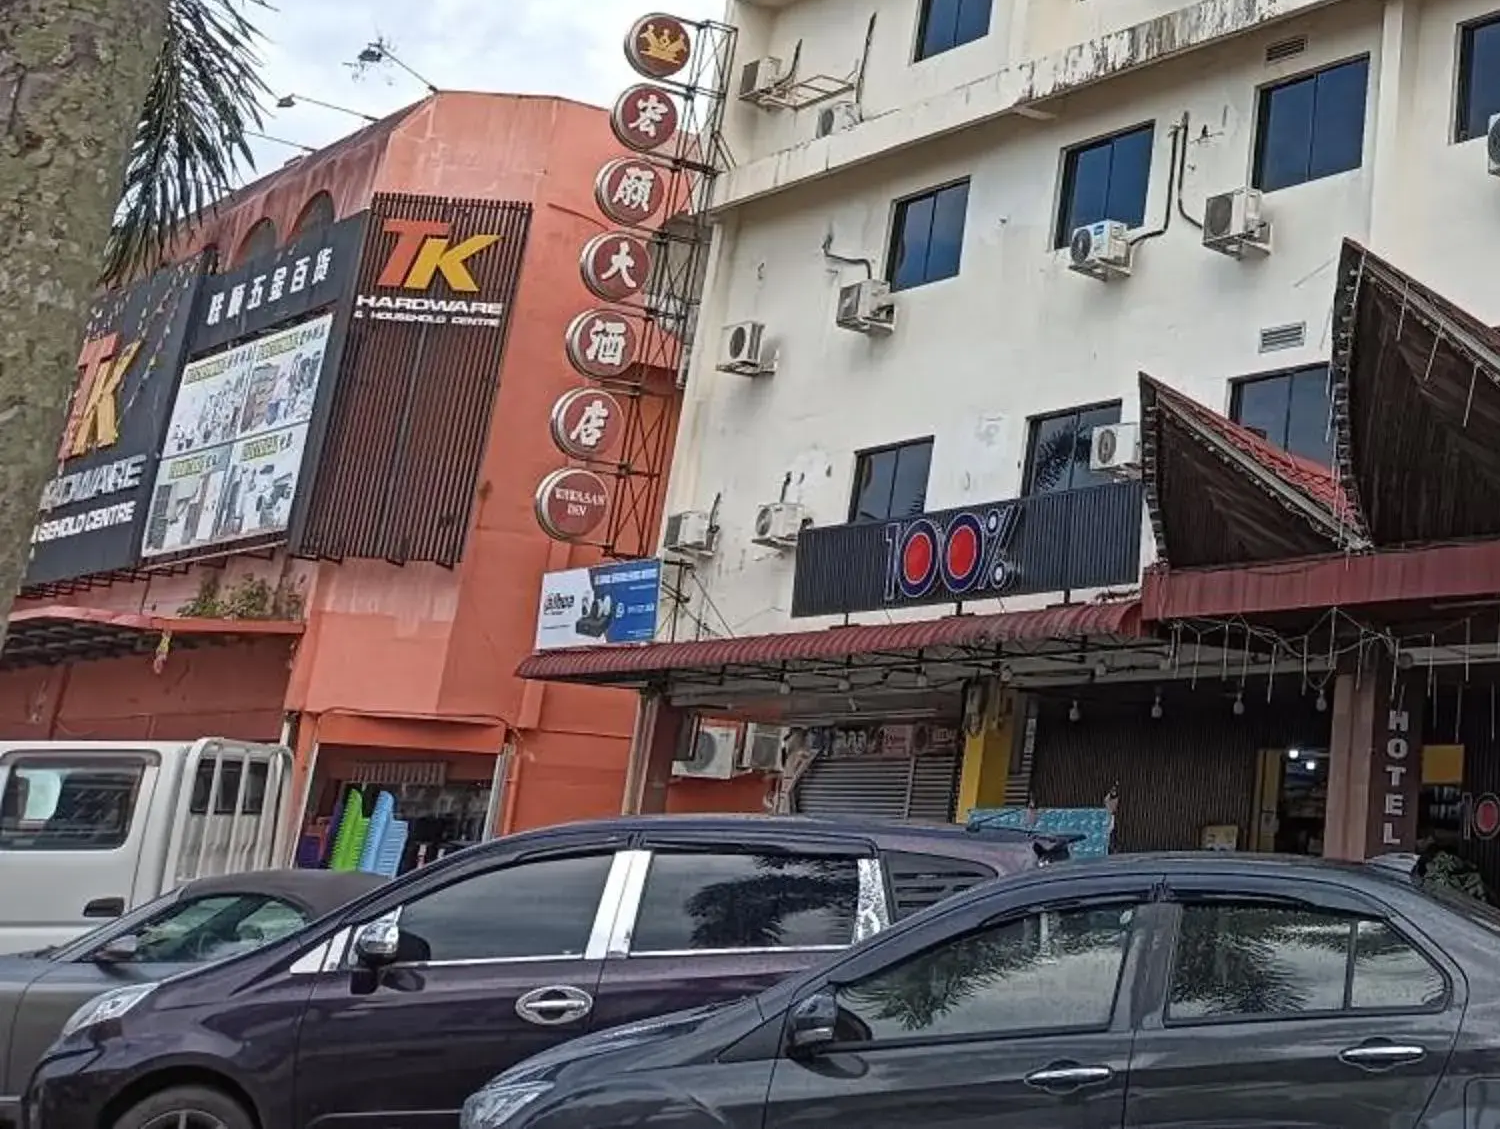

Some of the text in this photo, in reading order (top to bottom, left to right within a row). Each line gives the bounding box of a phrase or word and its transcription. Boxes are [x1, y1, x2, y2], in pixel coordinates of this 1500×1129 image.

[376, 220, 502, 293] TK
[356, 294, 502, 316] HARDWARE
[371, 311, 447, 325] HOUSEHOLD
[451, 315, 501, 328] CENTRE
[58, 331, 142, 461] TK
[84, 501, 137, 532] CENTRE
[884, 503, 1024, 603] 100%
[1382, 710, 1410, 845] HOTEL
